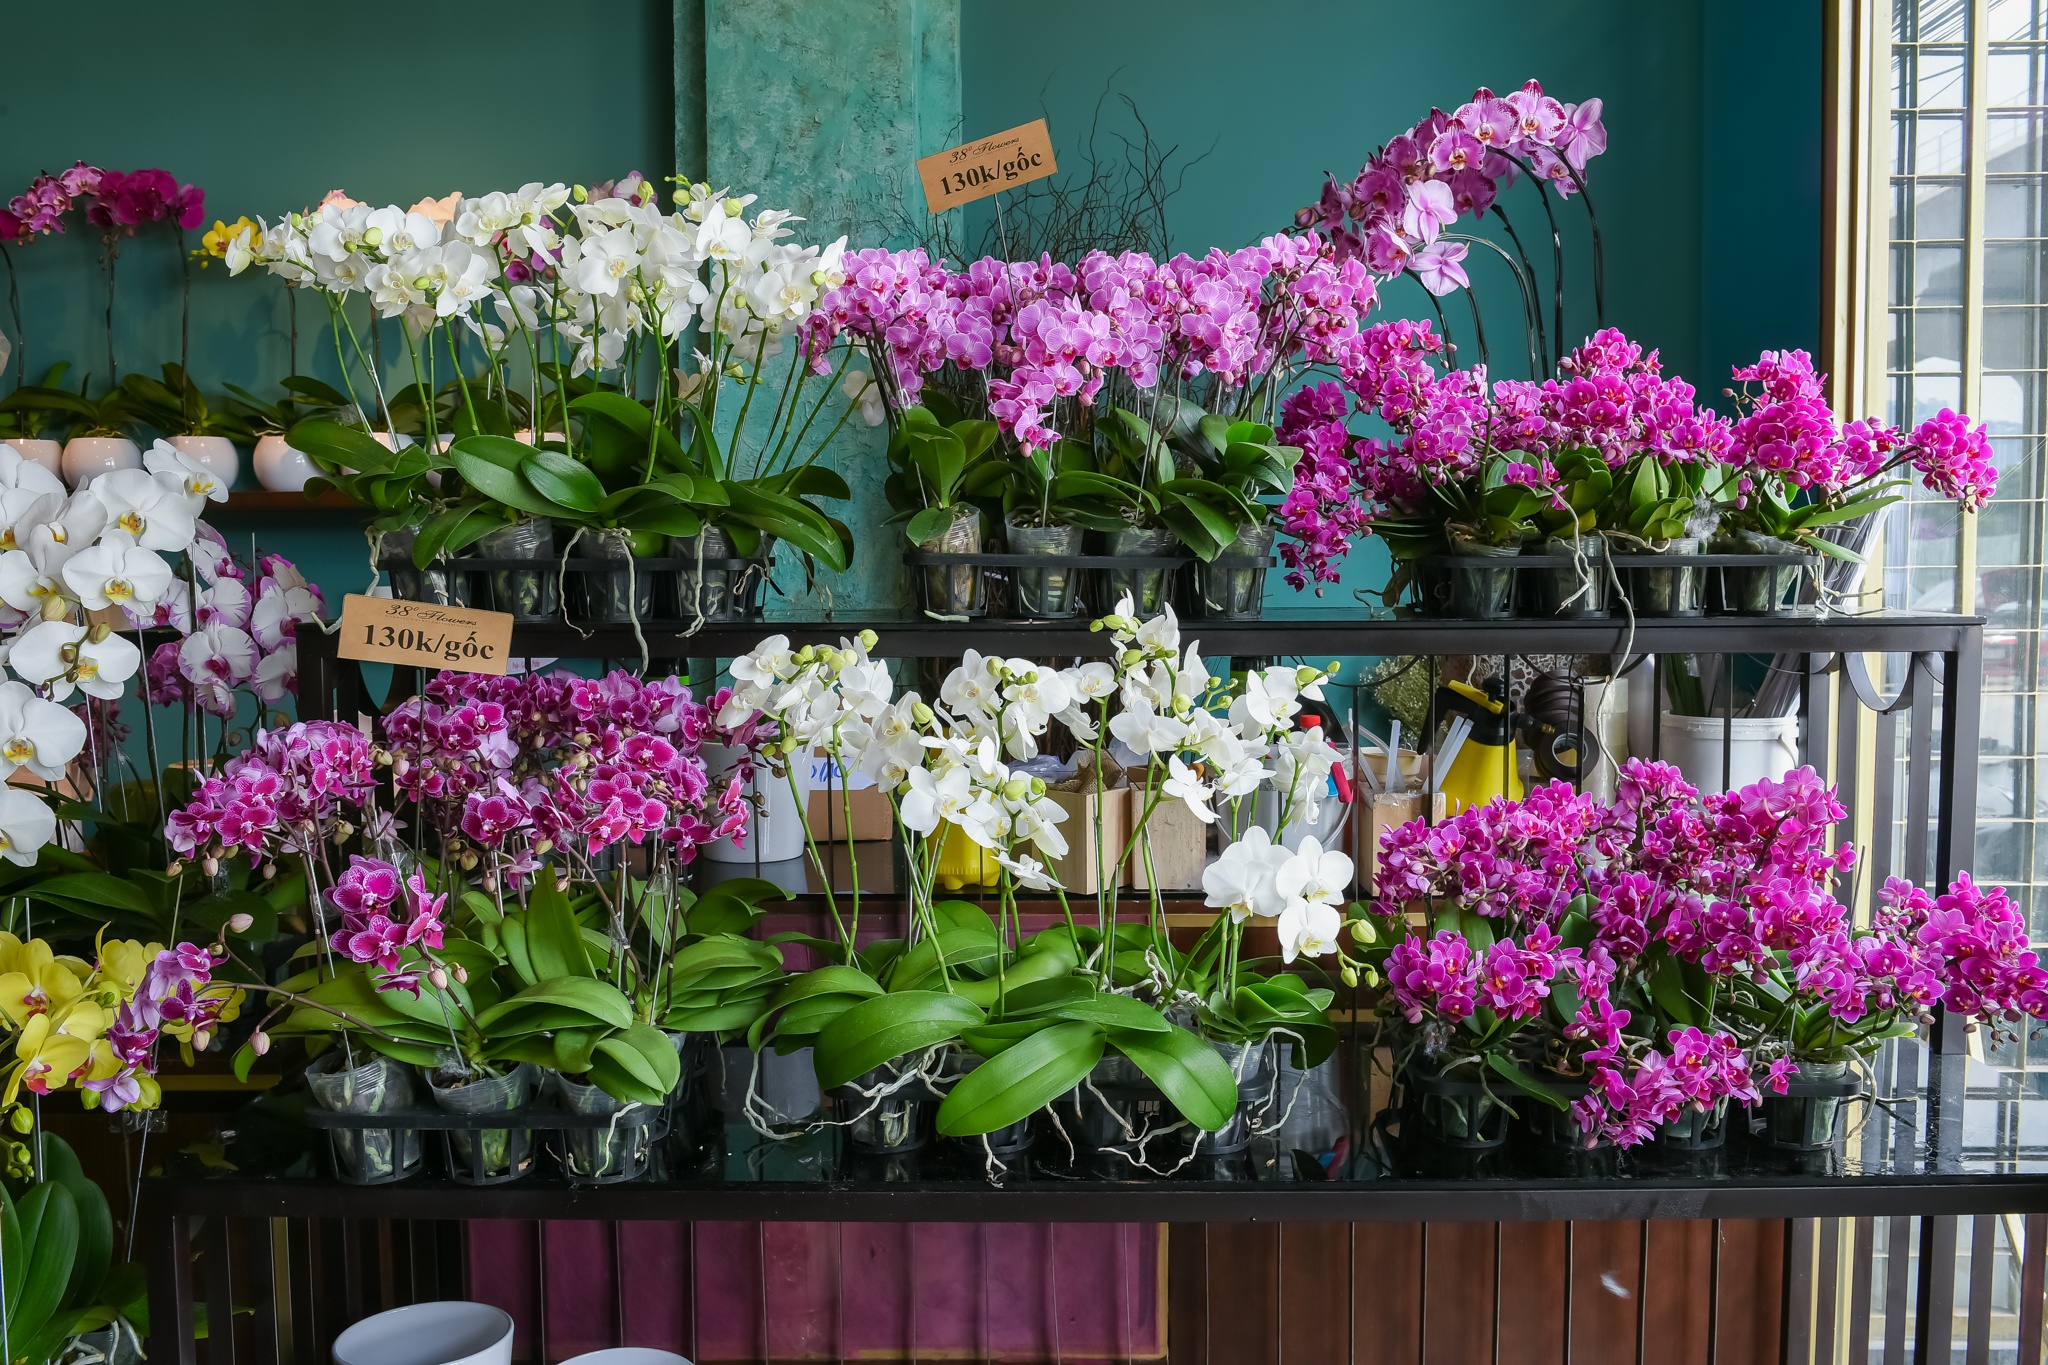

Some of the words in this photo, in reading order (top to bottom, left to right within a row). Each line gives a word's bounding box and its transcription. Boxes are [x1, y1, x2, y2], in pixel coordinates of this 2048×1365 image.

[972, 137, 1020, 156] Flowers
[940, 146, 1043, 196] 130k/gốc
[416, 609, 477, 626] Flowers
[363, 624, 495, 662] 130k/gốc
